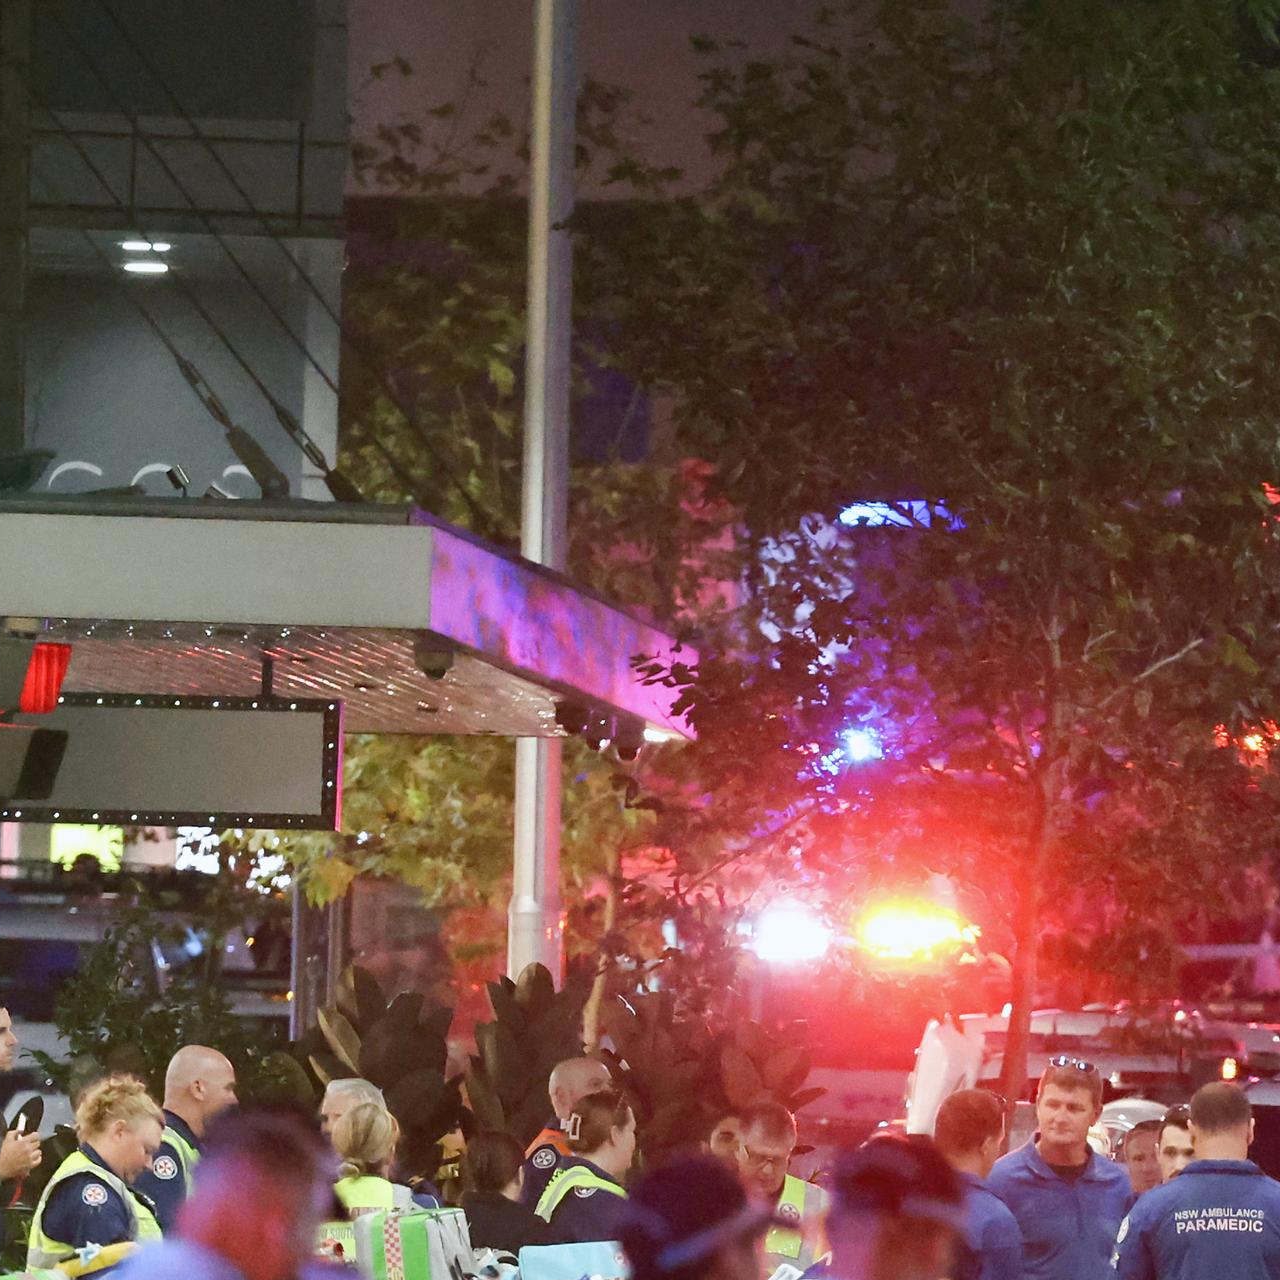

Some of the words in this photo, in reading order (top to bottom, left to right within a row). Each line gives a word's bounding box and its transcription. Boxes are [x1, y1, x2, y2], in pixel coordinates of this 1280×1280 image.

[1174, 1209, 1199, 1221] NSW
[1201, 1206, 1265, 1220] AMBULANCE
[1176, 1218, 1264, 1234] PARAMEDIC
